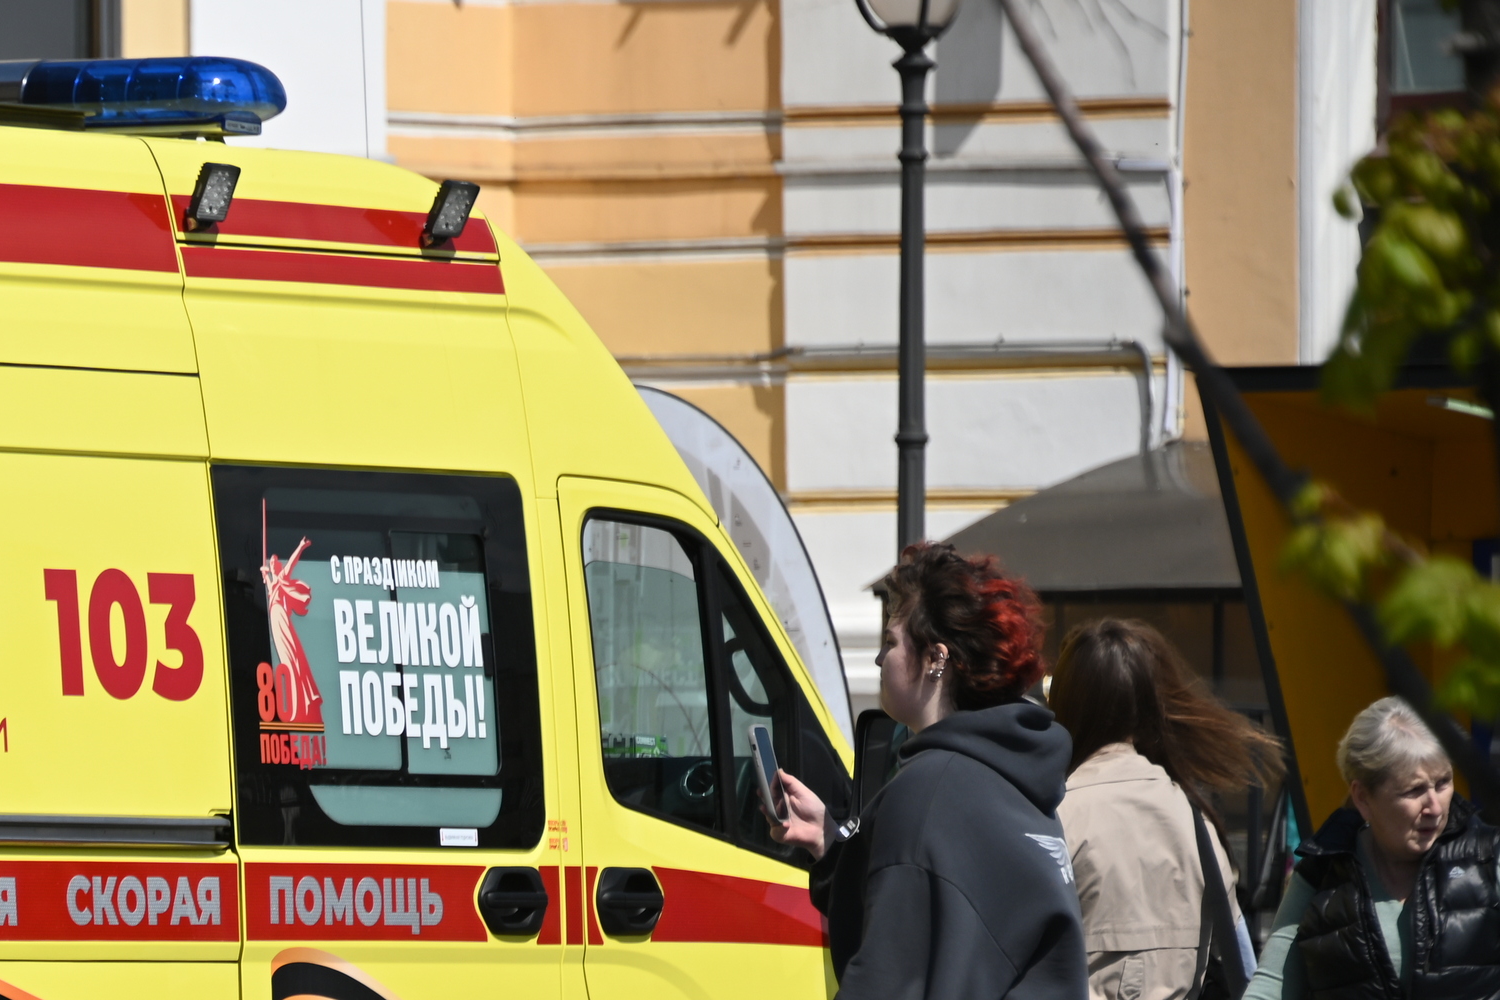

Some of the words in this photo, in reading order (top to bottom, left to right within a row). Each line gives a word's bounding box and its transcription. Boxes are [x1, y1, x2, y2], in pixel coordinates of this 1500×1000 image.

[330, 555, 341, 584] С
[343, 556, 440, 591] ПРАЗДНИКОМ
[43, 568, 204, 702] 103
[333, 595, 484, 667] ВЕЛИКОЙ
[256, 661, 296, 722] 80
[339, 670, 487, 749] ПОБЕДЫ!
[260, 733, 327, 770] ПОБЕДА!
[66, 874, 221, 926] СКОРАЯ
[269, 876, 444, 934] ПОМОЩЬ
